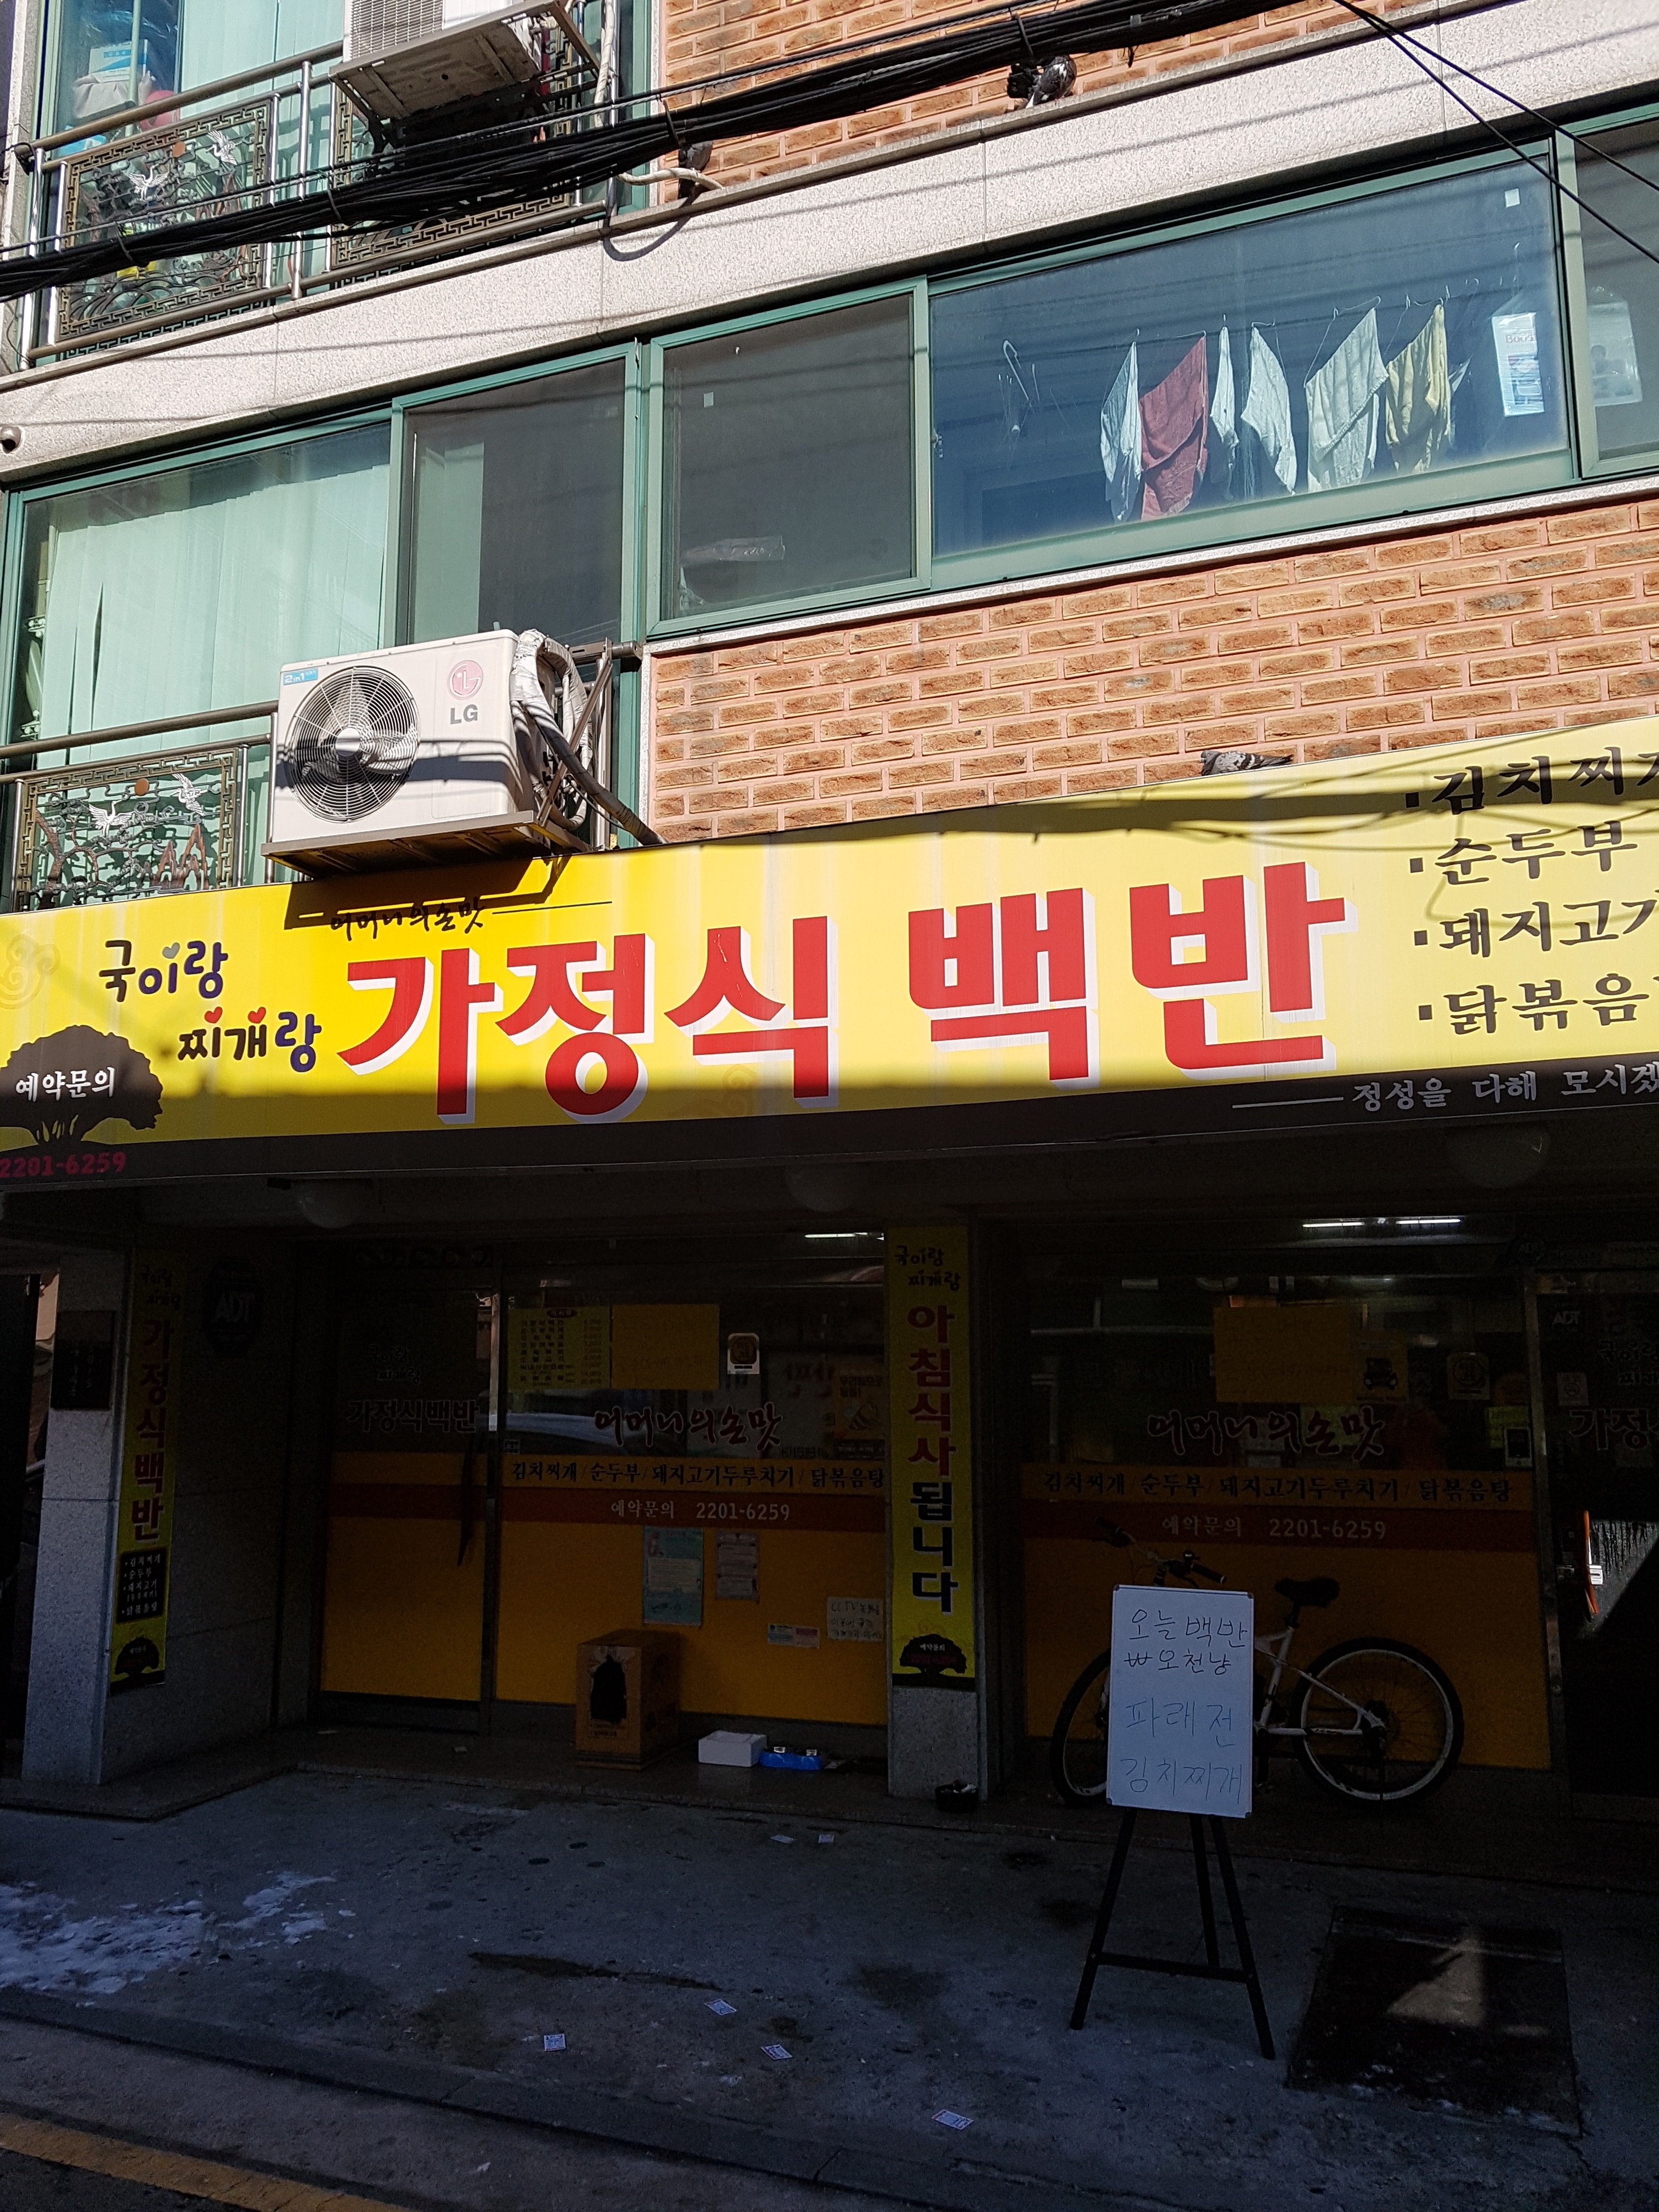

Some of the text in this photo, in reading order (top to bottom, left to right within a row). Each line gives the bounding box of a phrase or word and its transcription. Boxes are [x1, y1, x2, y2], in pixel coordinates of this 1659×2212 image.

[449, 704, 478, 724] LG
[1435, 821, 1638, 885] 순두부
[99, 939, 229, 1002] 국이랑
[337, 861, 1358, 1124] 가정식 백반
[1443, 973, 1659, 1035] 닭볶음
[178, 1007, 322, 1073] 찌개랑
[15, 1066, 116, 1103] 예약문의
[1352, 1077, 1452, 1111] 정성을
[1471, 1071, 1536, 1103] 다해
[0, 1152, 127, 1178] 2201-6259
[893, 1245, 945, 1266] 국이랑
[908, 1268, 961, 1290] 찌개랑
[212, 1291, 256, 1323] ADT
[1552, 1310, 1581, 1326] ADT
[1569, 1408, 1659, 1451] 가정
[512, 1462, 577, 1482] 김치찌개
[589, 1463, 641, 1483] 순두부
[811, 1468, 884, 1489] 닭볶음탕
[1043, 1471, 1125, 1493] 김치찌개
[1141, 1473, 1205, 1494] 순두부
[1419, 1478, 1513, 1502] 닭볶음탕
[611, 1500, 791, 1521] 예약문의 2201-6259
[1161, 1515, 1387, 1540] 예약문의 2201-6259
[129, 1567, 152, 1580] 순두부
[1120, 1757, 1243, 1804] 김치찌개
